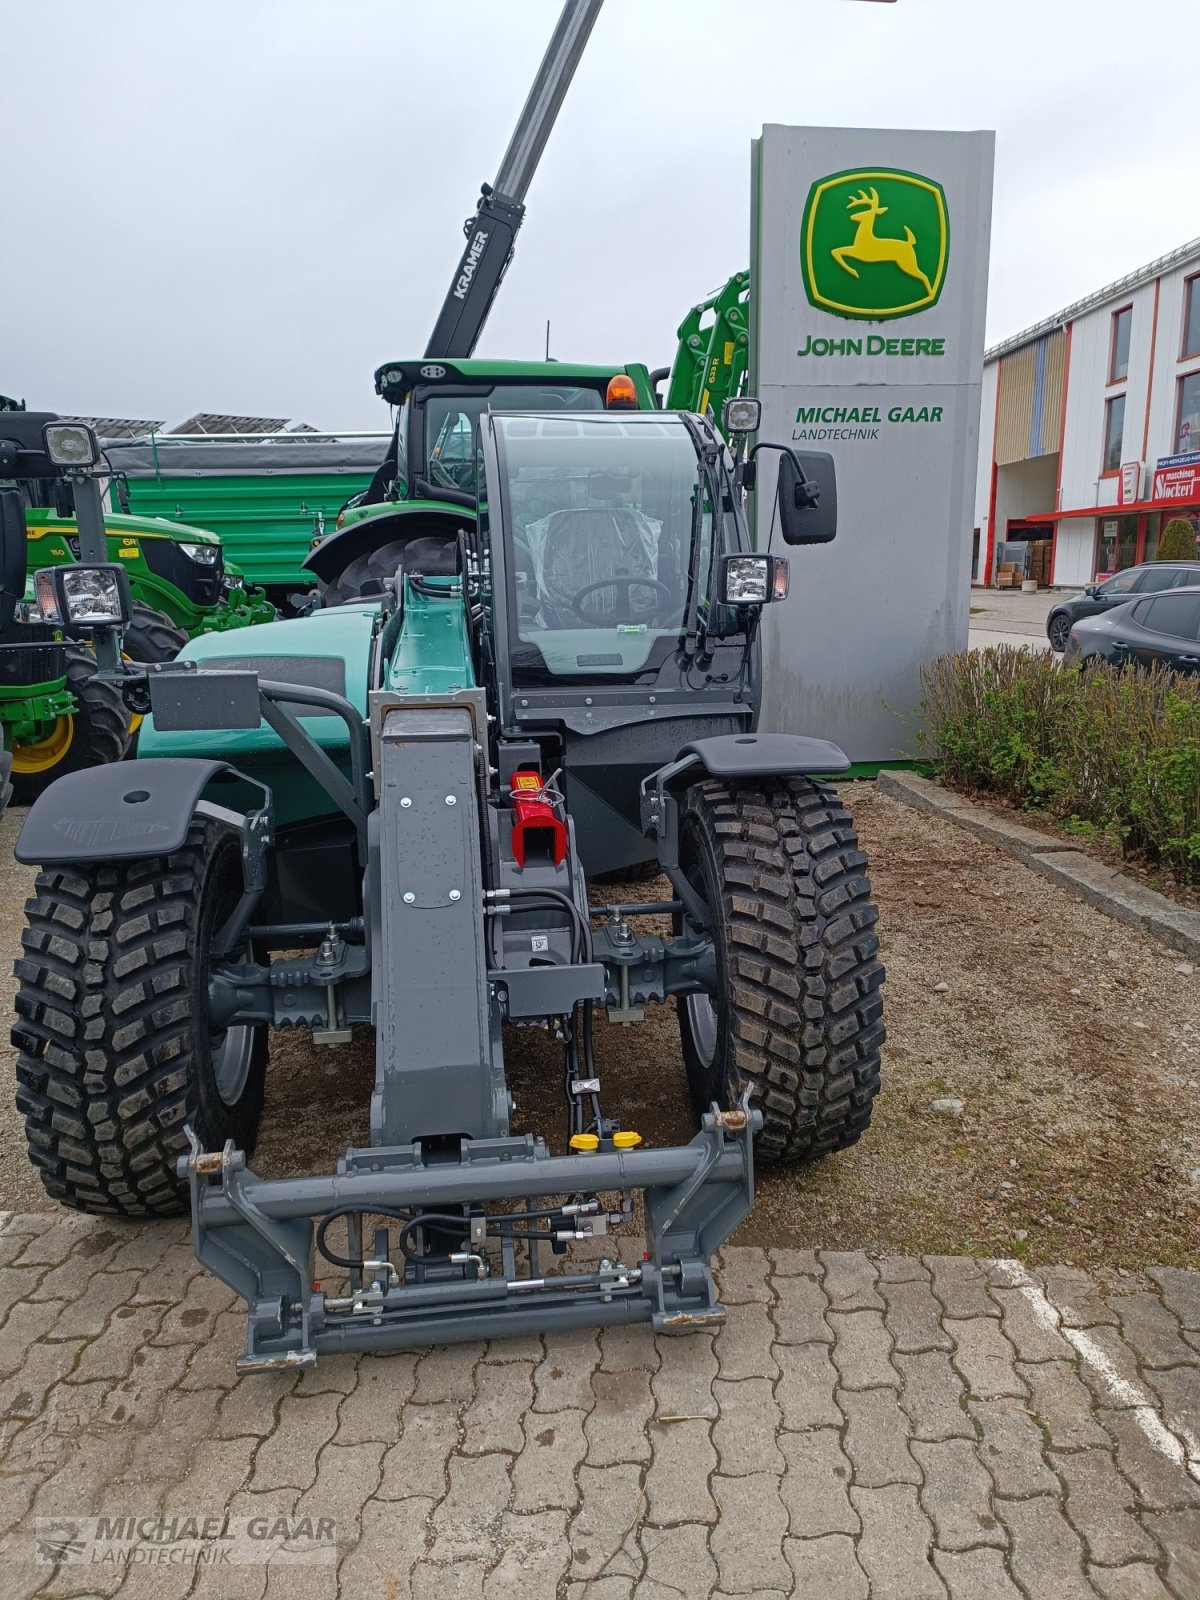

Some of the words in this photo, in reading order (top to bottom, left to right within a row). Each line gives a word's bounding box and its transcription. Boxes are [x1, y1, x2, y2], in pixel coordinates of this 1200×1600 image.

[453, 231, 489, 300] KRAMER
[797, 335, 862, 357] JOHN
[866, 335, 946, 356] DEERE
[795, 407, 882, 424] MICHAEL
[887, 407, 943, 423] GAAR
[790, 428, 880, 441] LANDTECHNIK
[1166, 469, 1196, 481] maschinen
[122, 538, 137, 546] 6R
